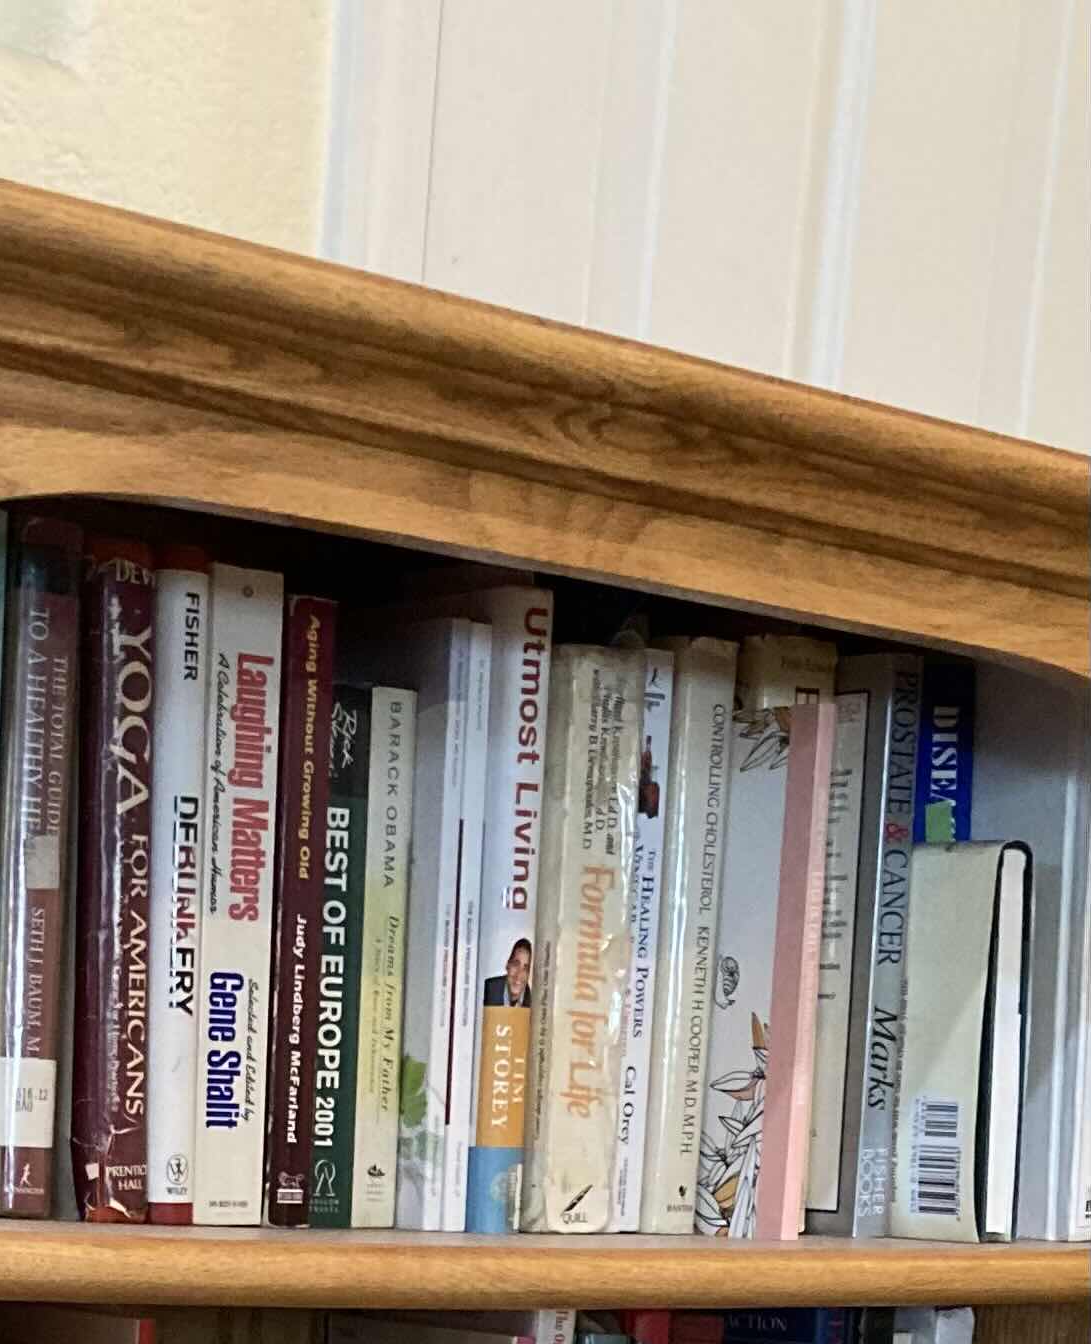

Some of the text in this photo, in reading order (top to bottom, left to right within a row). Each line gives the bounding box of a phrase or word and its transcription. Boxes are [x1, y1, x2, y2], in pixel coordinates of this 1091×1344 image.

[183, 591, 201, 682] FISHER
[219, 653, 230, 665] A
[211, 668, 227, 757] Celebration
[298, 614, 320, 880] Aging Without Growing Old
[503, 608, 547, 912] Utmost Living
[210, 774, 226, 853] American
[213, 759, 224, 773] of
[228, 652, 275, 923] Laughing Matters
[382, 700, 401, 888] BARACK OBAMA
[698, 703, 723, 911] CONTROLLING CHOLESTEROL
[114, 627, 152, 1116] YOGA FOR AMERICANS
[286, 913, 307, 1144] Judy Lindberg McFarland
[314, 805, 350, 1147] BEST OF EUROPE 2001
[206, 971, 243, 1130] Gene Shalit
[490, 1024, 525, 1129] TIM STOREY
[868, 1007, 897, 1110] Marks
[618, 1066, 636, 1145] Cal Orey
[857, 1148, 875, 1217] BOOKS
[871, 1147, 887, 1214] FISHER
